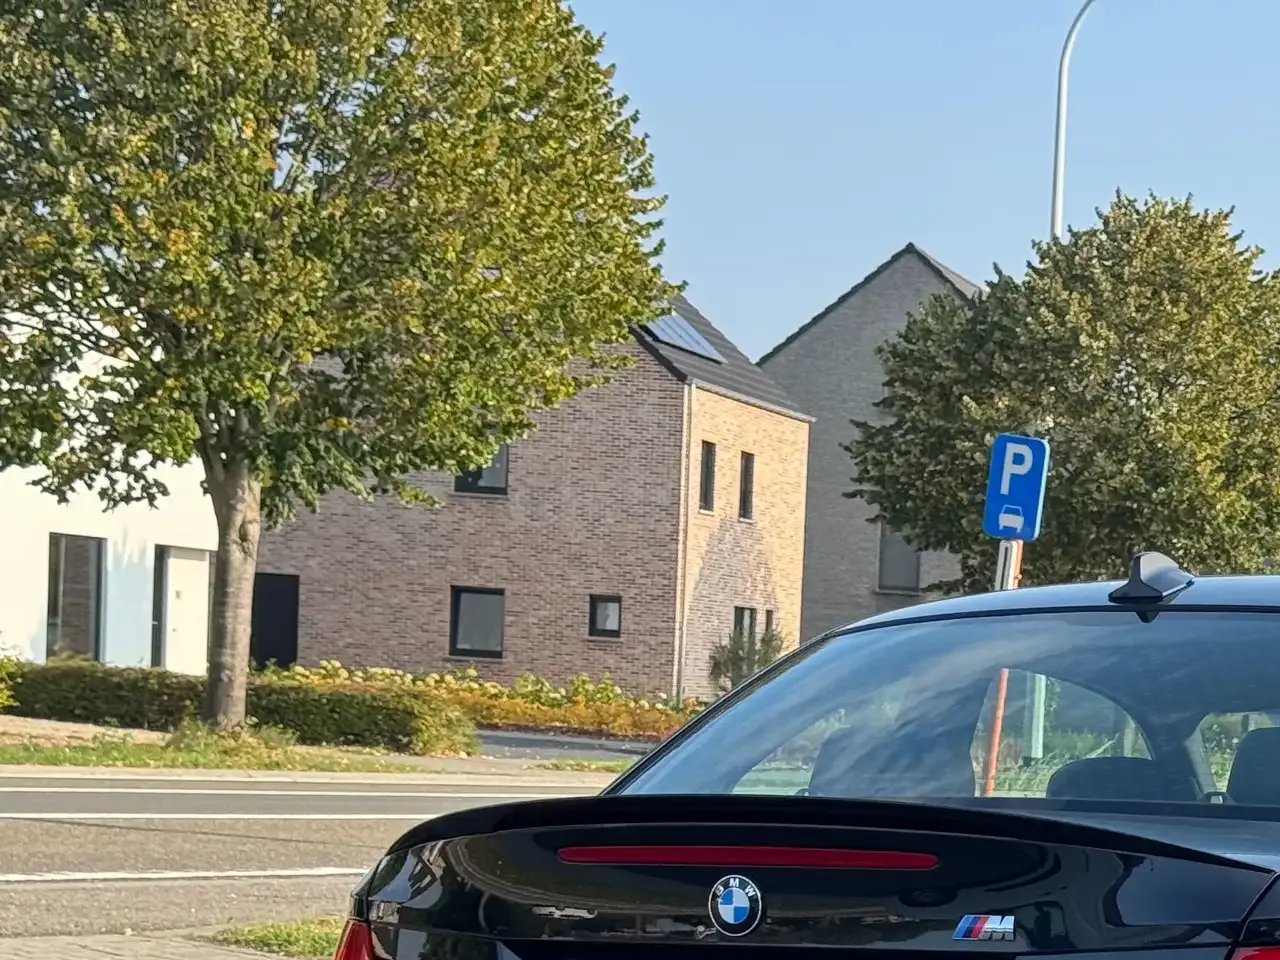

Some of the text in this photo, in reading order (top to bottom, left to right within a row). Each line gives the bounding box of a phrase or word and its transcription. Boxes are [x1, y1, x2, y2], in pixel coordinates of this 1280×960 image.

[1000, 442, 1034, 496] P
[715, 877, 757, 897] BMW
[977, 914, 1016, 941] M
